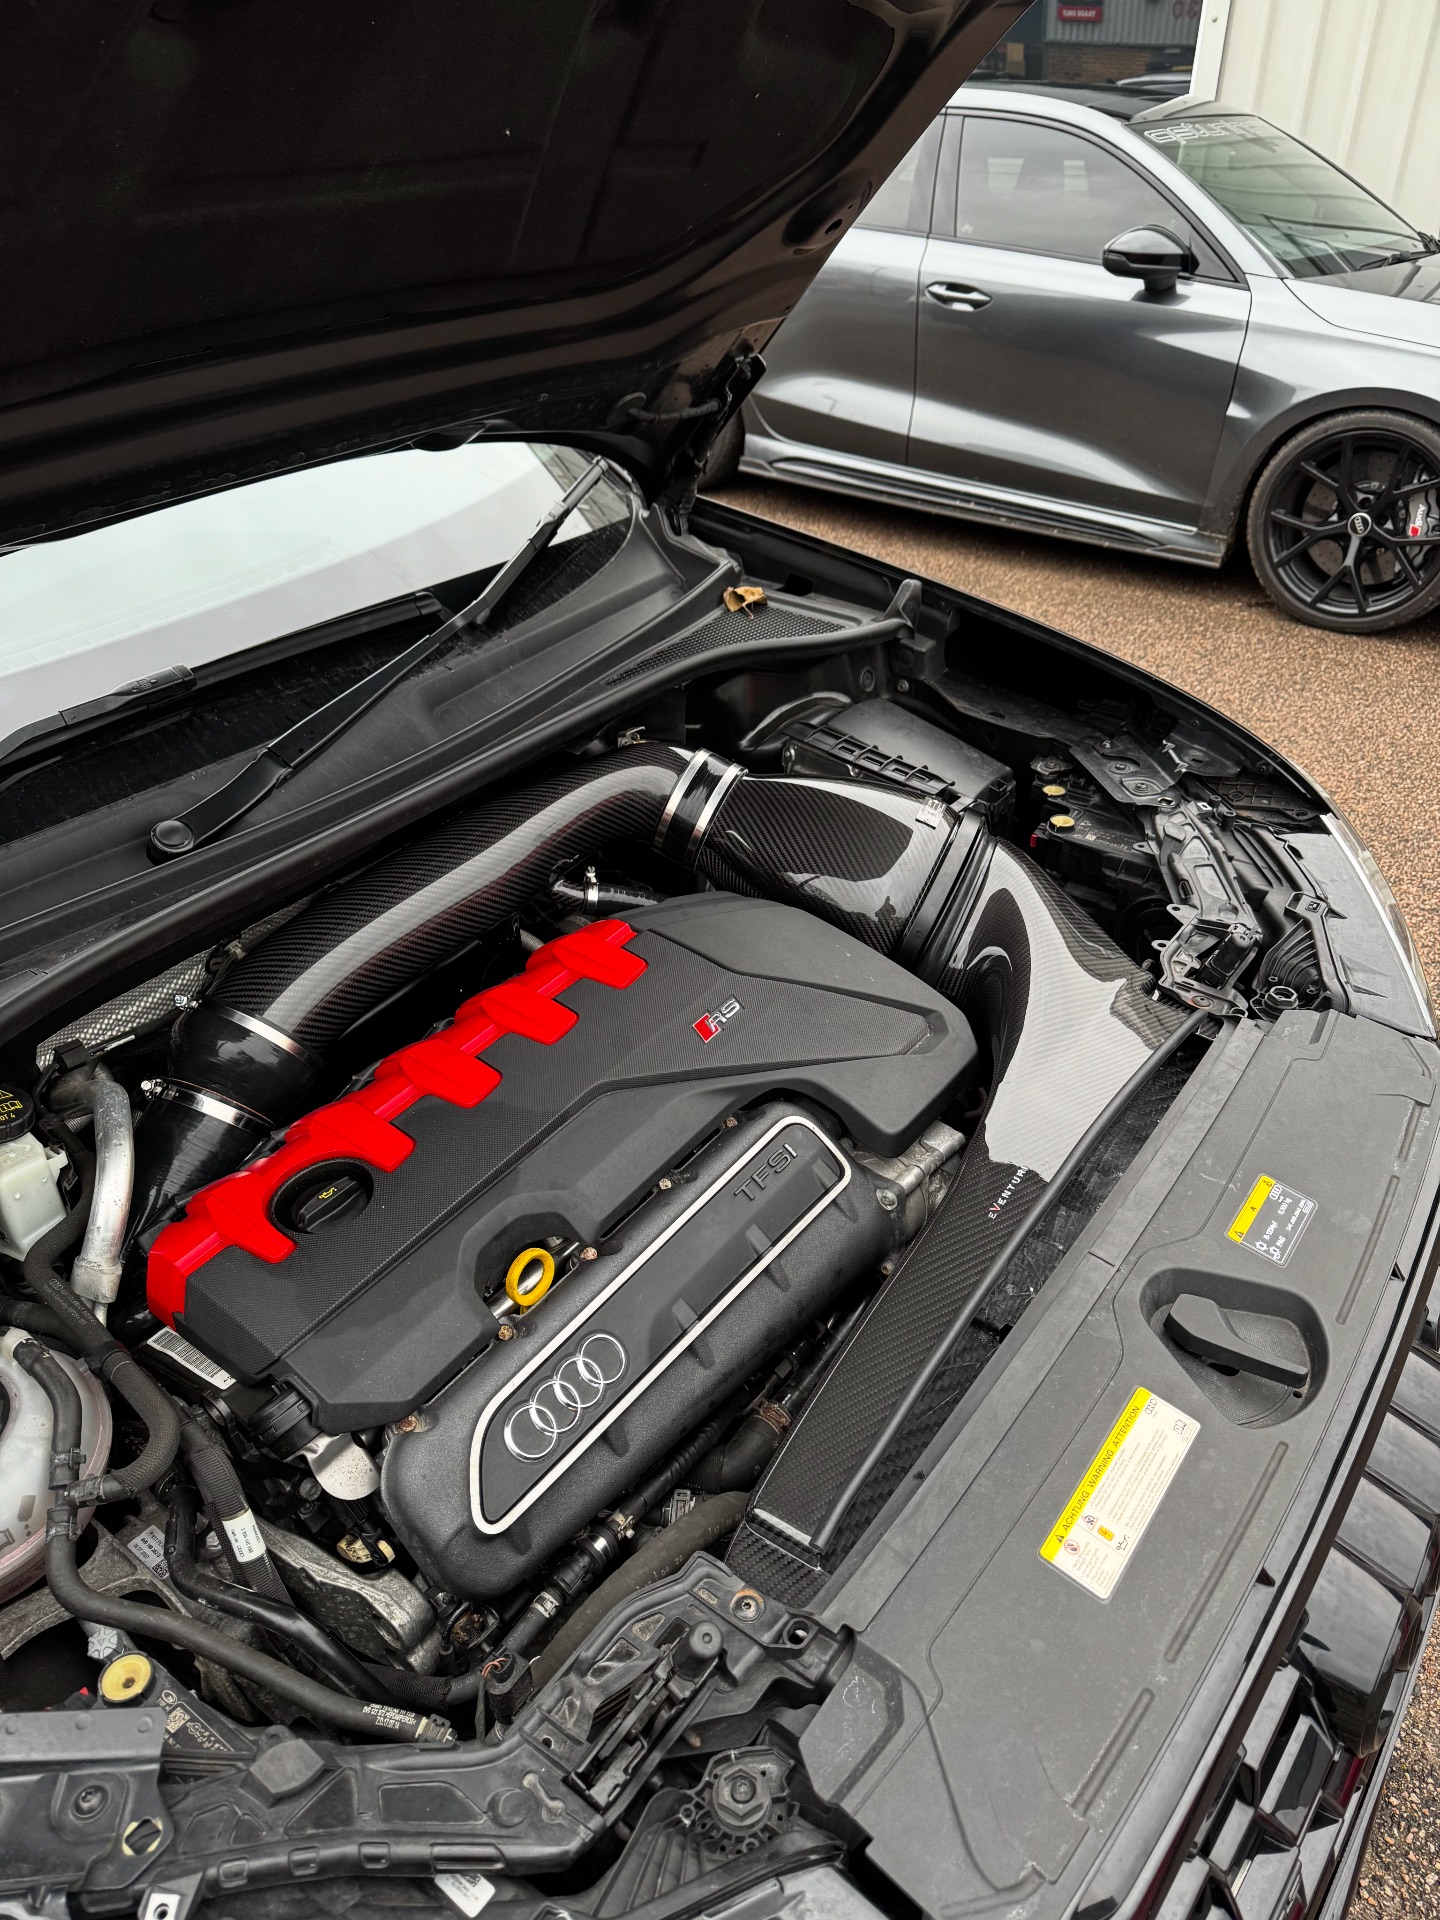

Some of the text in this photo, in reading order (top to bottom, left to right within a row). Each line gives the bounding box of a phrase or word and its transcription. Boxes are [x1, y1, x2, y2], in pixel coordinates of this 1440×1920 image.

[1415, 503, 1426, 527] Audi
[702, 998, 740, 1034] RS
[733, 1143, 798, 1202] TFSI
[1063, 1405, 1140, 1532] ACHTUNG WARNING ATTENTION
